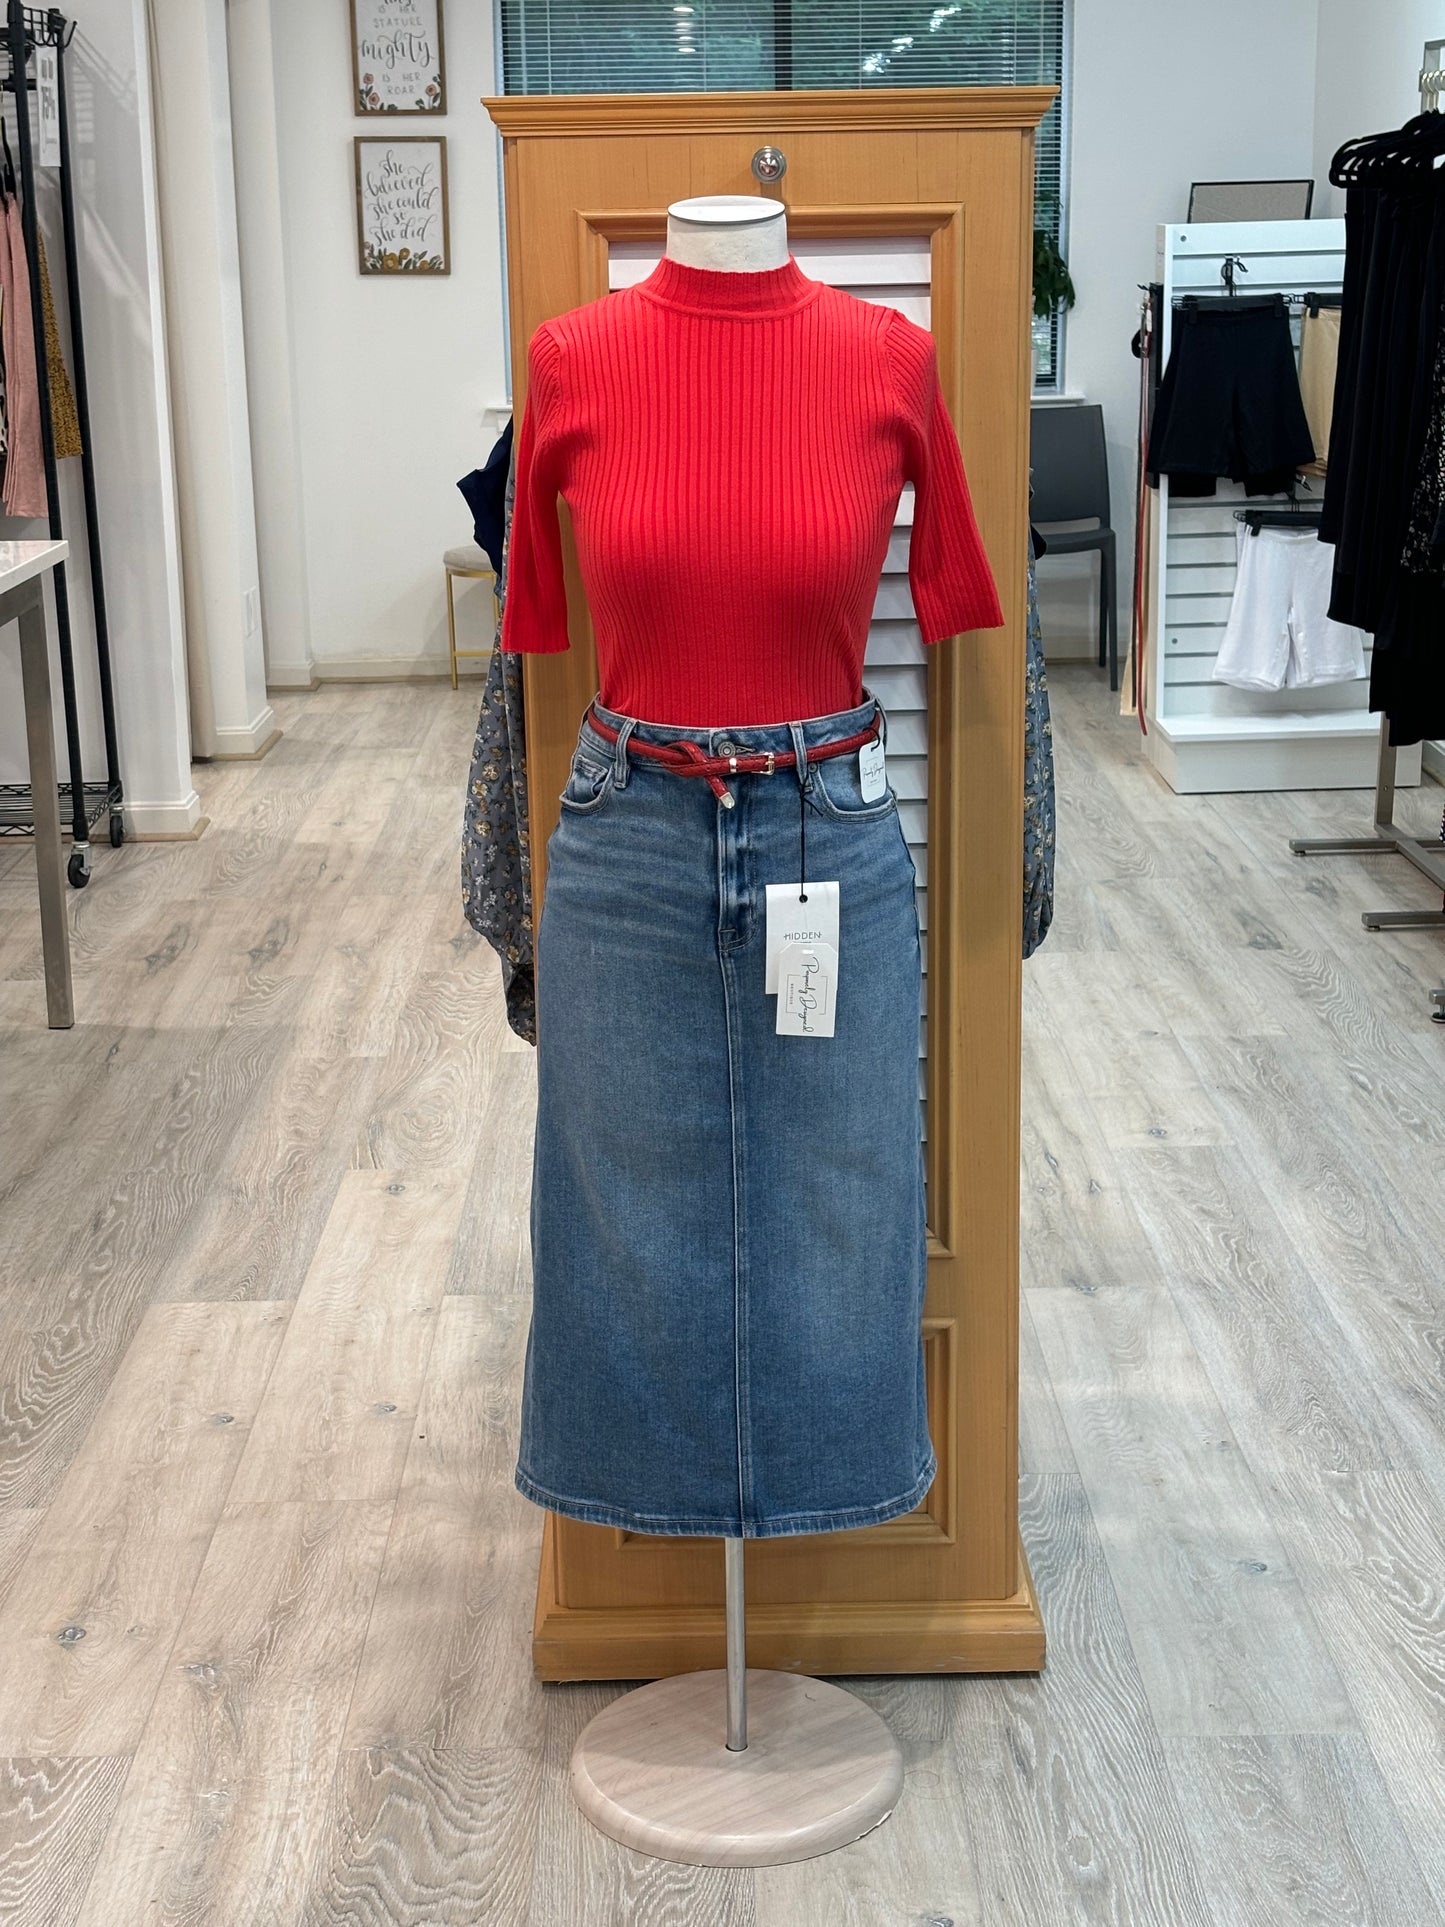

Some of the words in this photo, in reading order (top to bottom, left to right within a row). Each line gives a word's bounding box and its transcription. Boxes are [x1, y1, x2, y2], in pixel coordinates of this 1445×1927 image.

[373, 16, 423, 29] STATURE
[361, 29, 435, 69] mighty
[402, 72, 421, 82] HER
[387, 85, 416, 95] ROAR
[784, 931, 822, 941] HIDDEN
